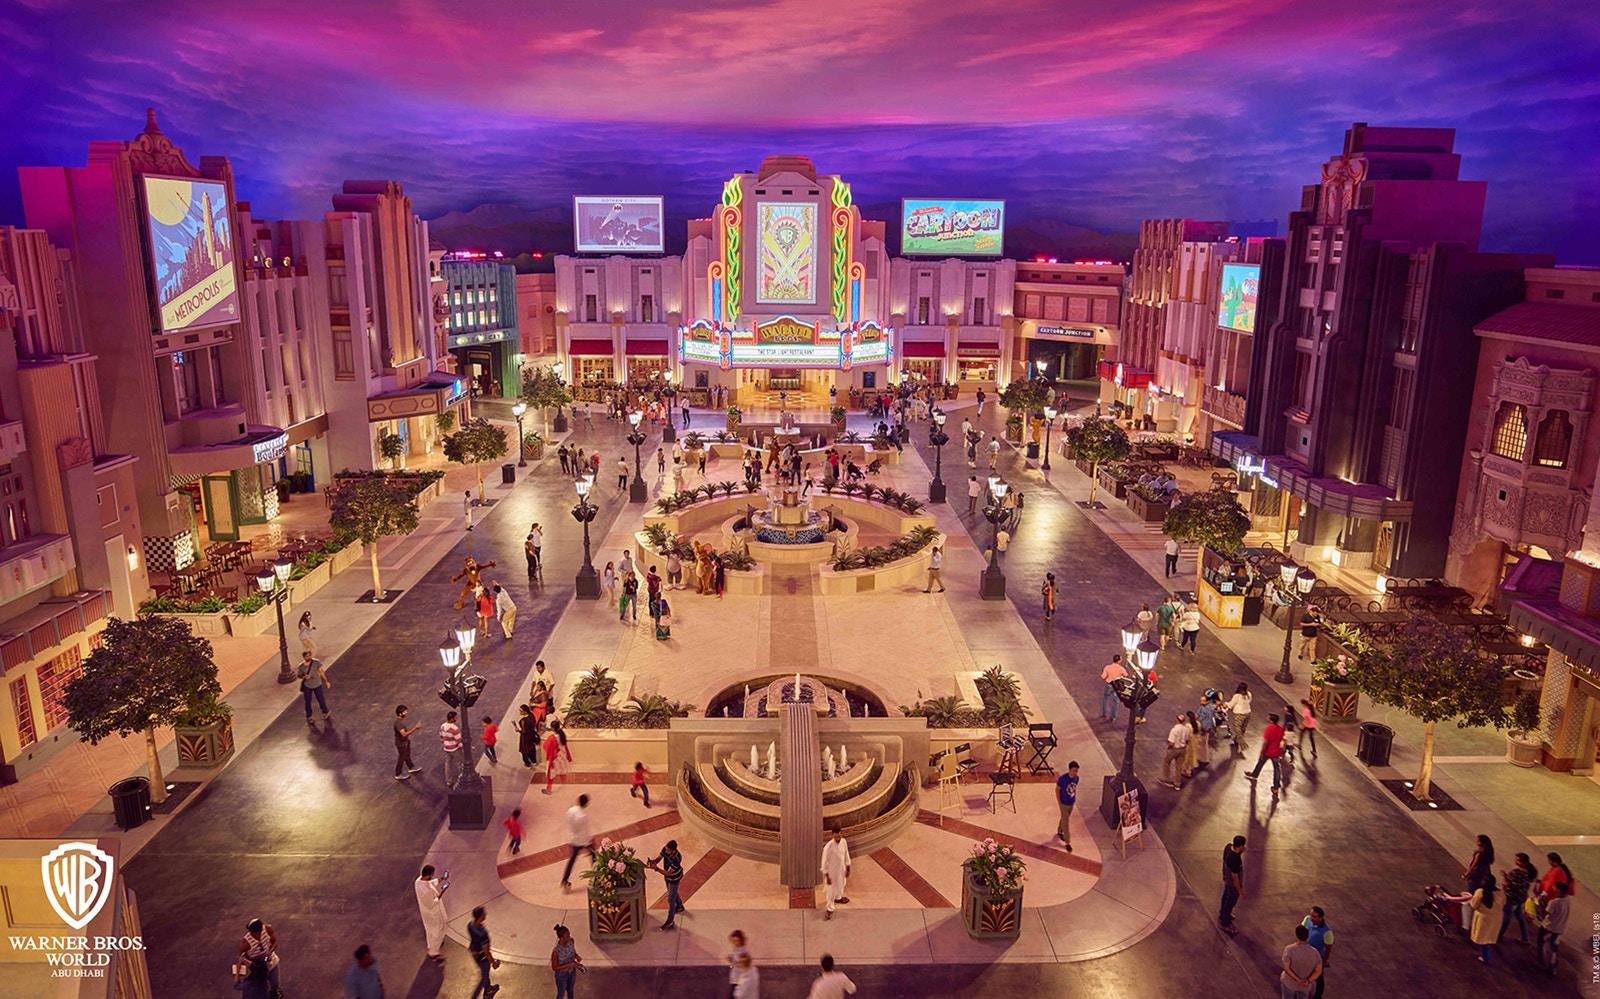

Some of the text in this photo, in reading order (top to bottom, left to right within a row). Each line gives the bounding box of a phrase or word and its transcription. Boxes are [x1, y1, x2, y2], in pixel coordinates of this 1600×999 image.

[906, 208, 1000, 238] CARTOON
[174, 280, 220, 322] METROPOLIS
[761, 324, 812, 338] WARNER
[1236, 456, 1266, 476] Hollywood
